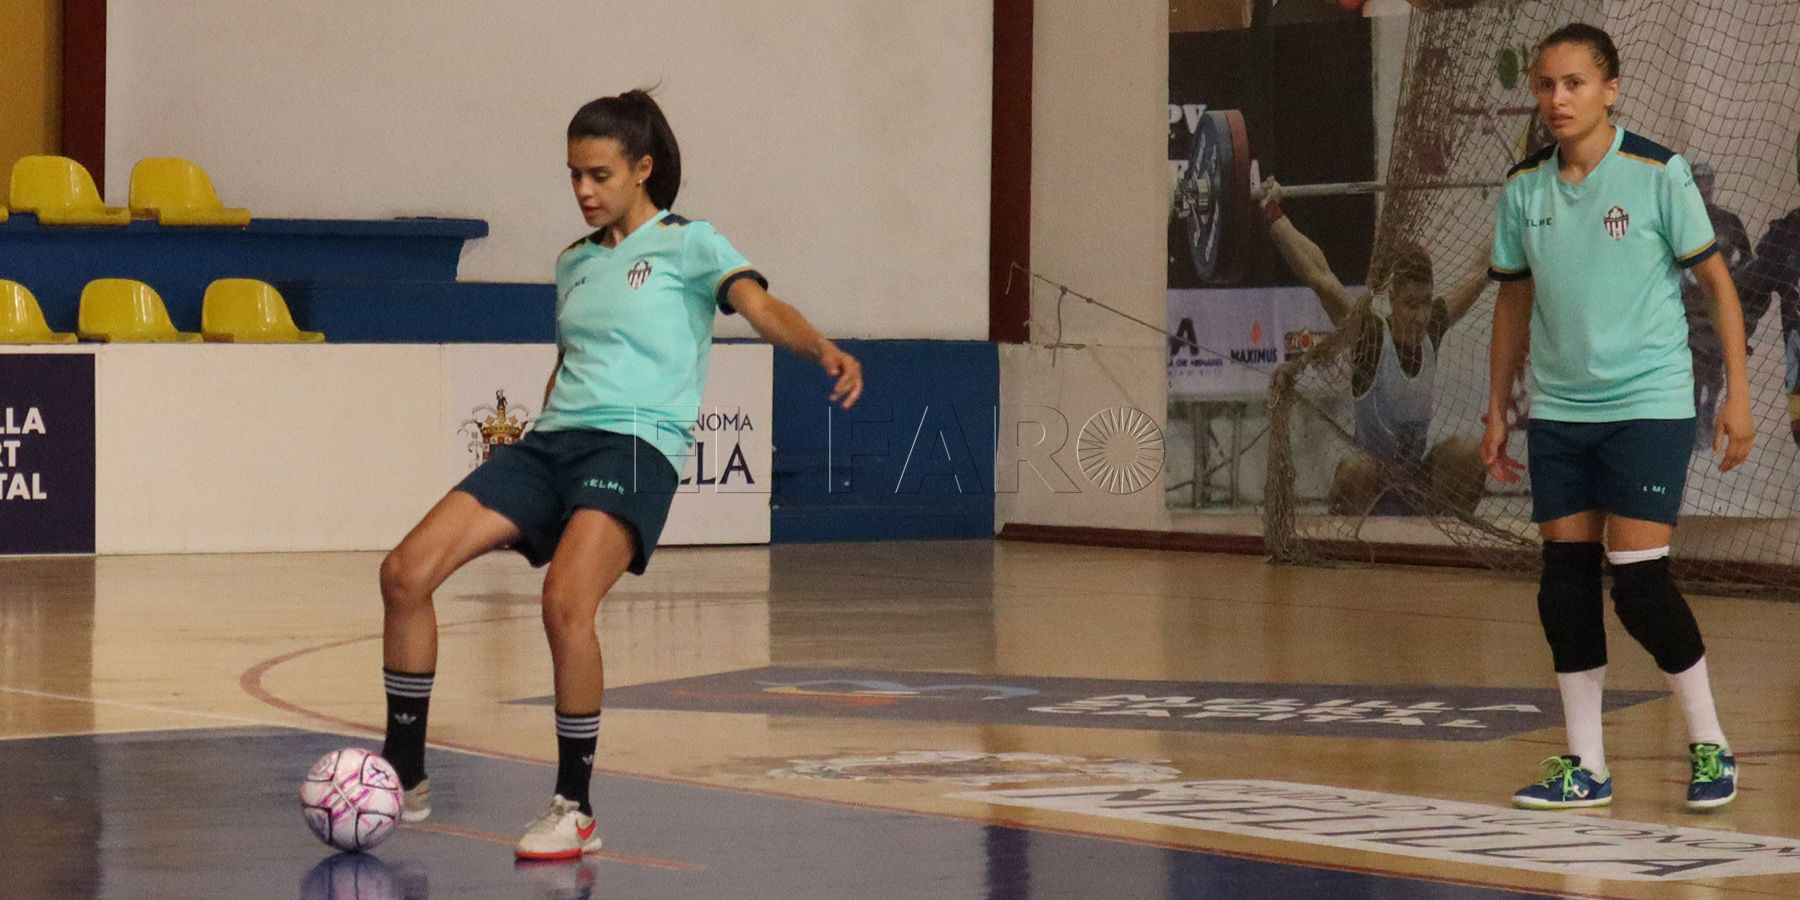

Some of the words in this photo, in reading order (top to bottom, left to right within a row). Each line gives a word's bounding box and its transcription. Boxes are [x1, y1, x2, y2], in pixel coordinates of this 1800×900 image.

[0, 440, 21, 467] T
[680, 442, 755, 484] LA
[1028, 706, 1488, 728] CAPITAL
[1080, 694, 1541, 712] MELILLA
[1182, 783, 1437, 812] CIUDAD
[1006, 788, 1743, 877] MELILLA
